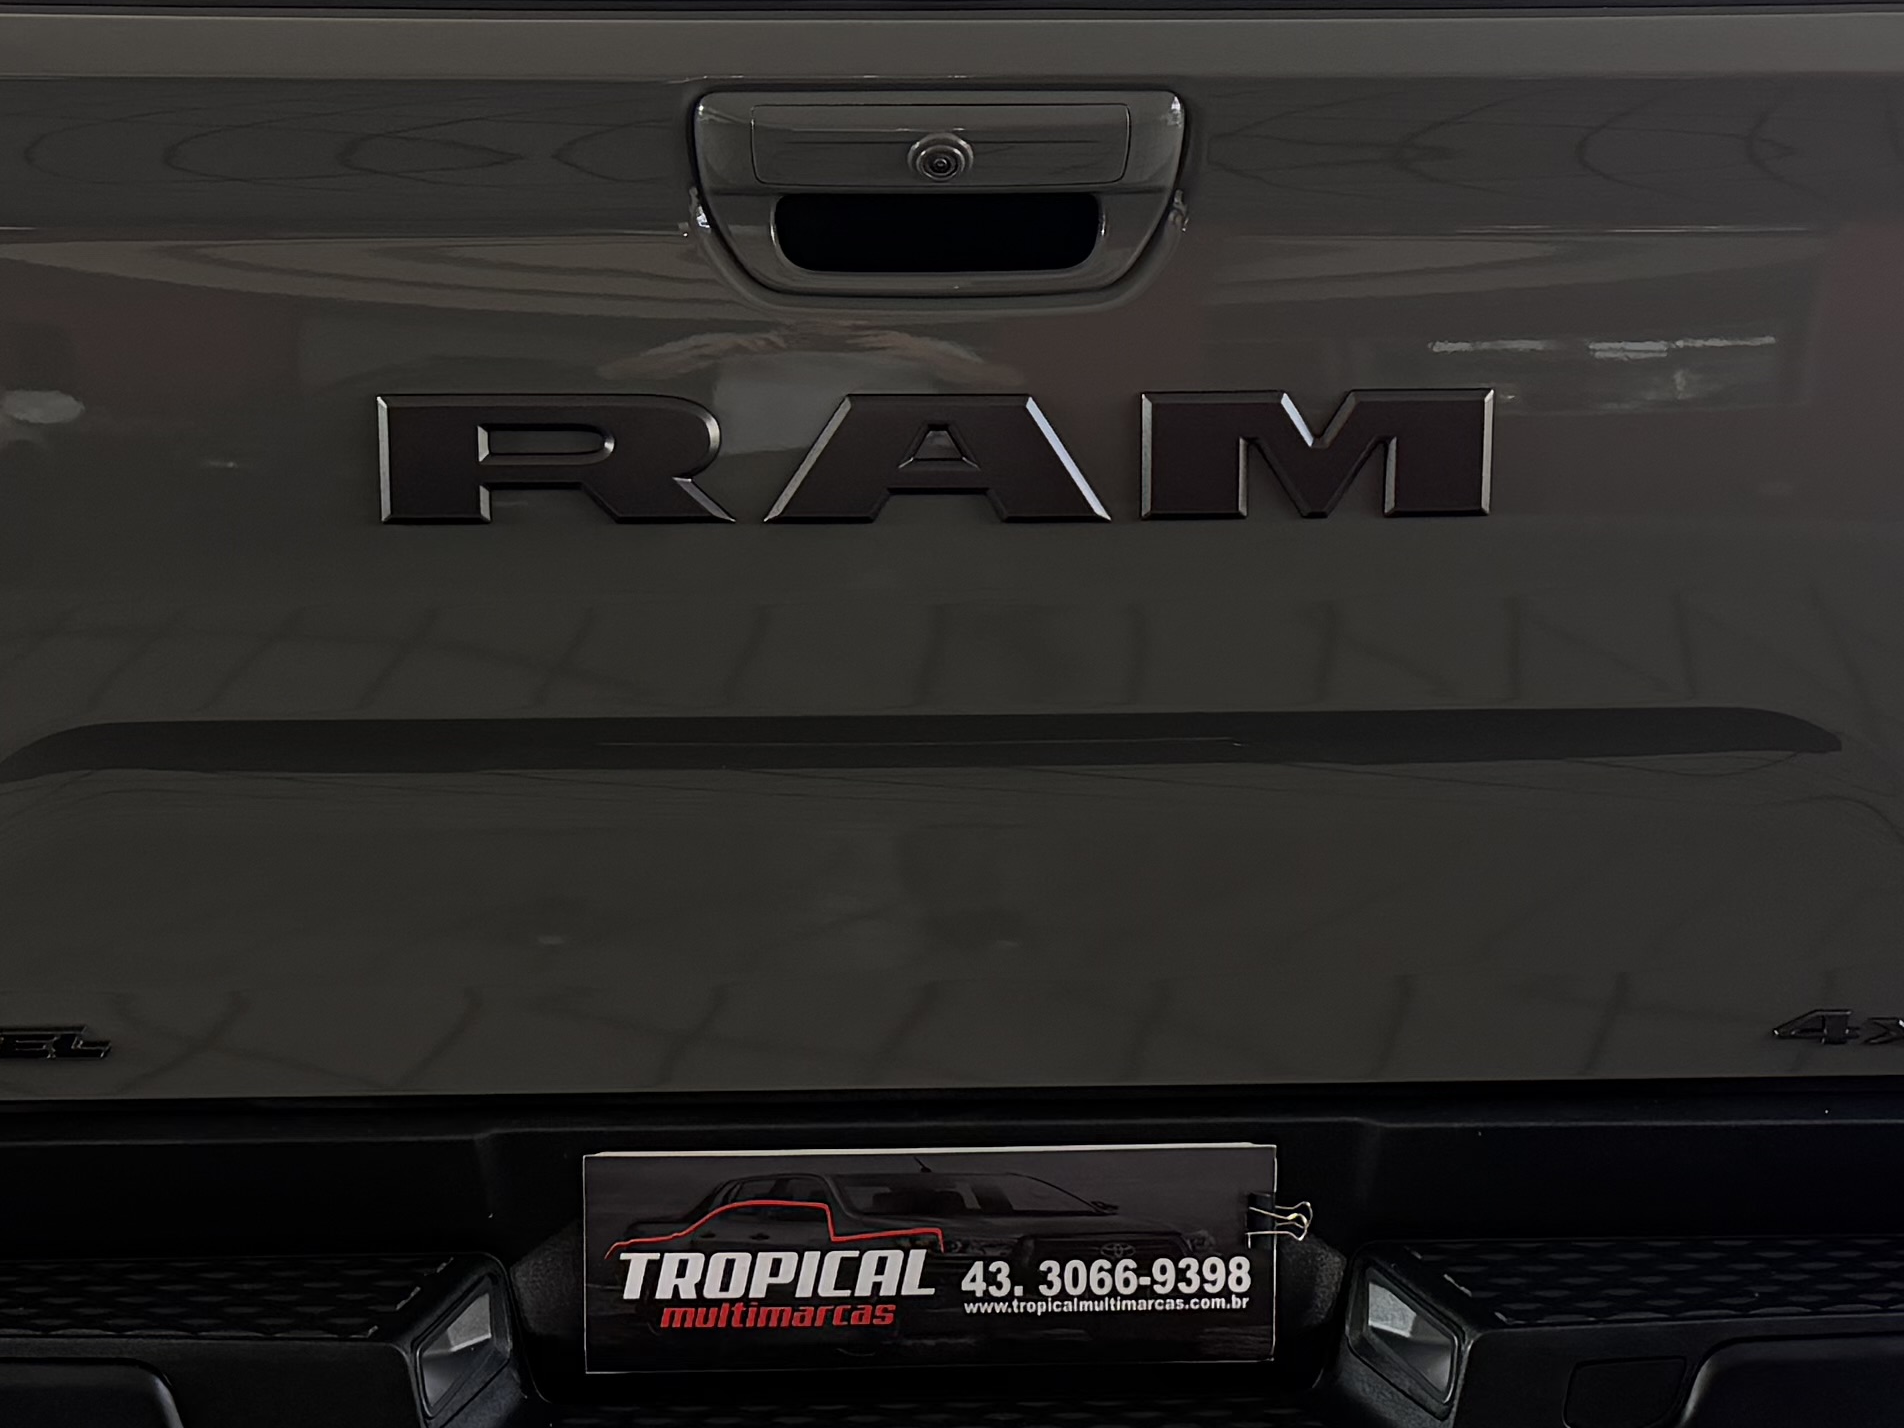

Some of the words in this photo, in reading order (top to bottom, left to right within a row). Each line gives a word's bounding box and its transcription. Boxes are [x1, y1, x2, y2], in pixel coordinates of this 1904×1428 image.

[376, 388, 1495, 525] RAM
[619, 1249, 936, 1300] TROPICAL
[960, 1260, 1024, 1298] 43.
[1038, 1256, 1252, 1297] 3066-9398
[659, 1302, 896, 1329] multimarcas
[964, 1294, 1250, 1316] www.tropicalmultimarcas.com.br
